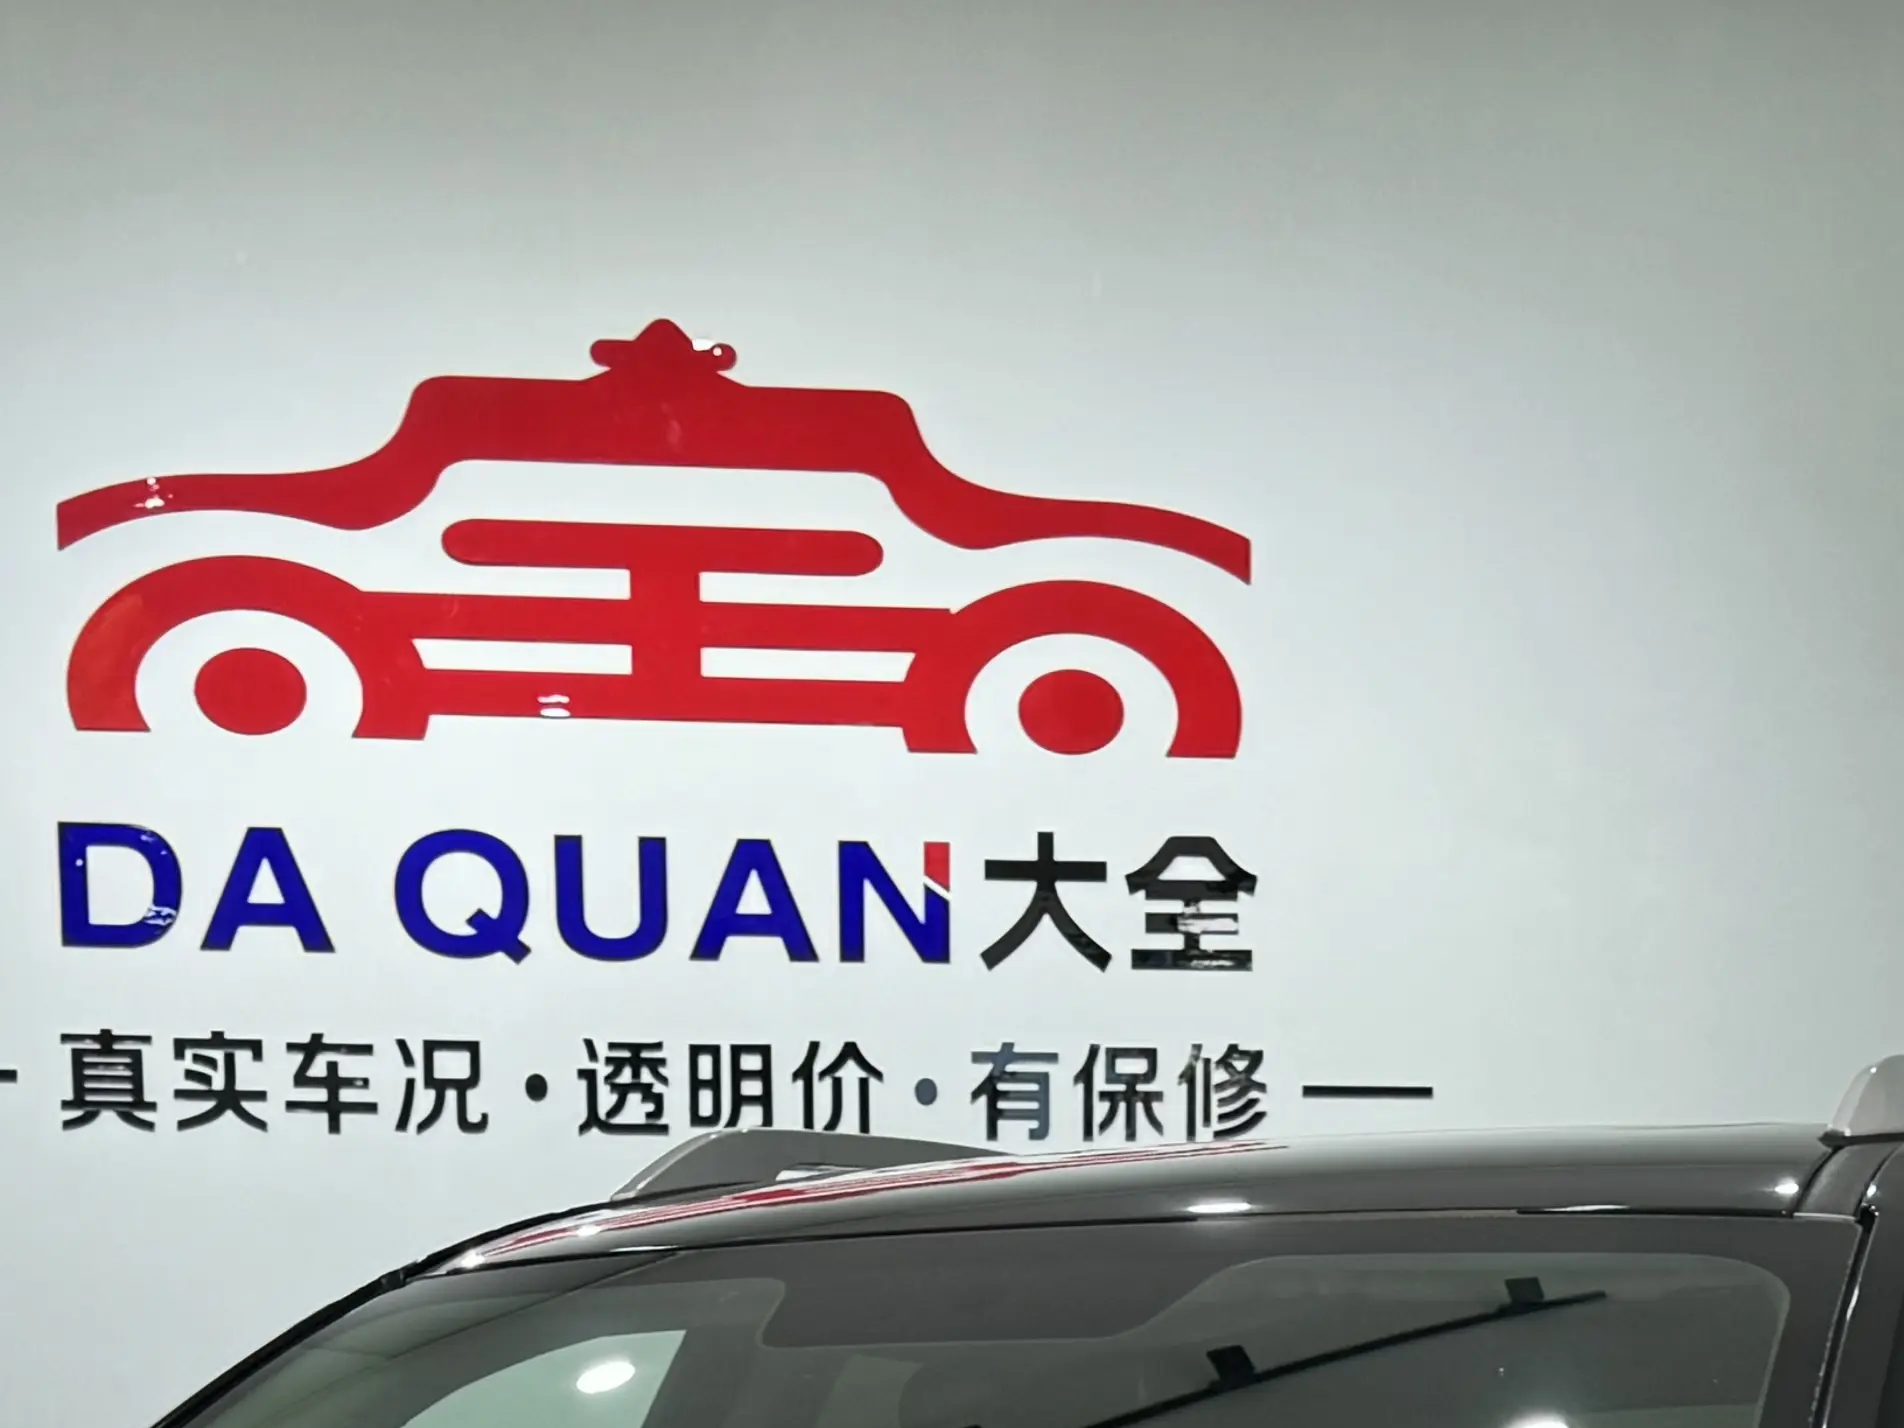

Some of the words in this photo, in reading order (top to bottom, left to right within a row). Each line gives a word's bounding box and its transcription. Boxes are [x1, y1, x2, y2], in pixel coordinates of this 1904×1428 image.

[58, 822, 336, 952] DA
[395, 830, 951, 965] QUAN
[981, 830, 1259, 972] 大全
